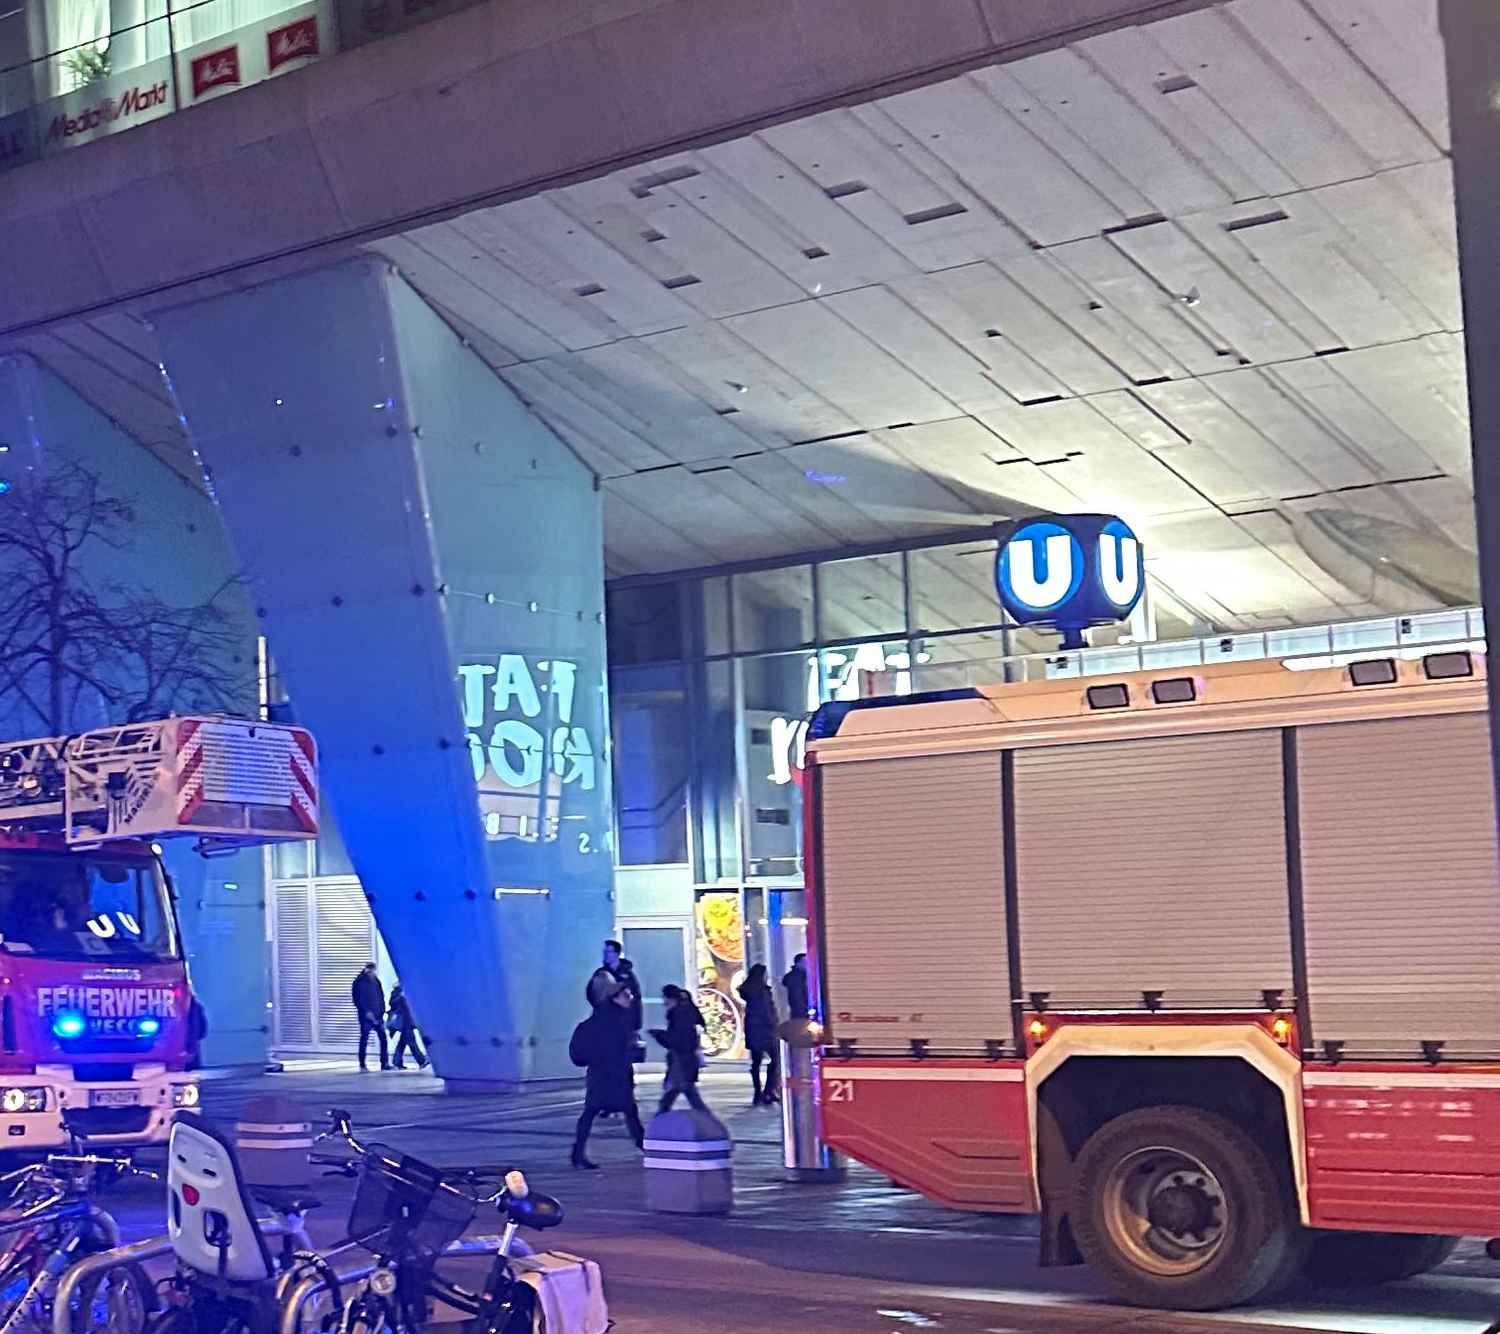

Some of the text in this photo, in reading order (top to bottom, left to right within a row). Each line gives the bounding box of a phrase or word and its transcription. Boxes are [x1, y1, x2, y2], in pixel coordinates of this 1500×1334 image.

[1009, 533, 1138, 607] U U
[38, 987, 176, 1017] FEUERWEHR
[829, 1080, 854, 1101] 21
